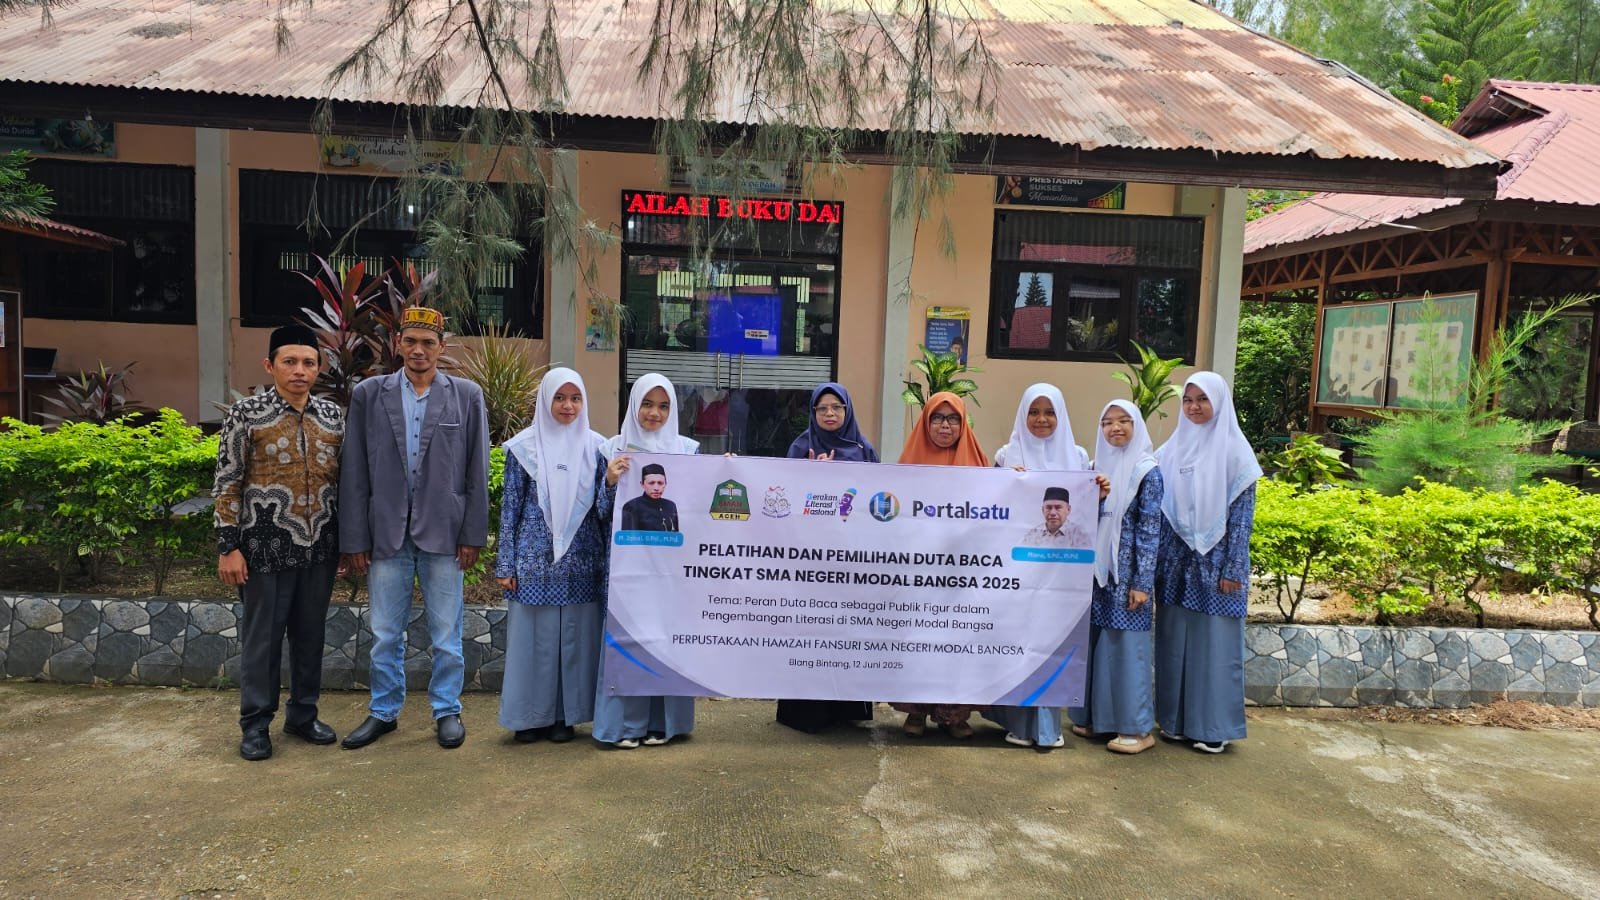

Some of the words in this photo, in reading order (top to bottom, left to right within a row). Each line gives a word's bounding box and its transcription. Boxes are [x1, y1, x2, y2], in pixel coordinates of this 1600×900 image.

[1029, 184, 1063, 192] SUKSES
[717, 198, 791, 221] BUKU
[805, 500, 833, 508] Literasi
[806, 493, 838, 502] Gerakan
[803, 508, 837, 517] Nasional
[912, 500, 1010, 521] Portalsatu
[698, 543, 785, 559] PELATIHAN
[788, 547, 823, 561] DAN
[826, 549, 910, 565] PEMILIHAN
[913, 552, 956, 566] DUTA
[959, 554, 1003, 568] BACA
[683, 565, 753, 580] TINGKAT
[756, 567, 792, 582] SMA
[794, 570, 850, 584] NEGERI
[853, 572, 910, 587] MODAL
[913, 575, 978, 588] BANGSA
[982, 576, 1020, 590] 2025
[708, 594, 742, 605] Tema:
[745, 596, 777, 607] Peran
[780, 597, 807, 608] Duta
[809, 598, 838, 609] Baca
[840, 600, 886, 613] sebagai
[889, 601, 921, 612] Publik
[923, 602, 951, 615] Figur
[952, 604, 990, 615] dalam
[702, 610, 793, 626] Pengembangan
[795, 614, 834, 625] Literasi
[836, 615, 847, 625] di
[850, 616, 874, 626] SMA
[876, 617, 912, 630] Negeri
[914, 618, 949, 629] Modal
[951, 619, 994, 632] Bangsa
[672, 634, 760, 647] PERPUSTAKAAN
[762, 637, 812, 649] HAMZAH
[814, 639, 861, 651] FANSURI
[864, 641, 889, 652] SMA
[891, 642, 931, 653] NEGERI
[933, 644, 975, 655] MODAL
[977, 645, 1025, 656] BANGSA
[788, 658, 814, 669] Blang
[816, 659, 850, 670] Bintang,
[853, 660, 861, 668] 12
[862, 661, 881, 669] Juni
[883, 661, 904, 670] 2025
